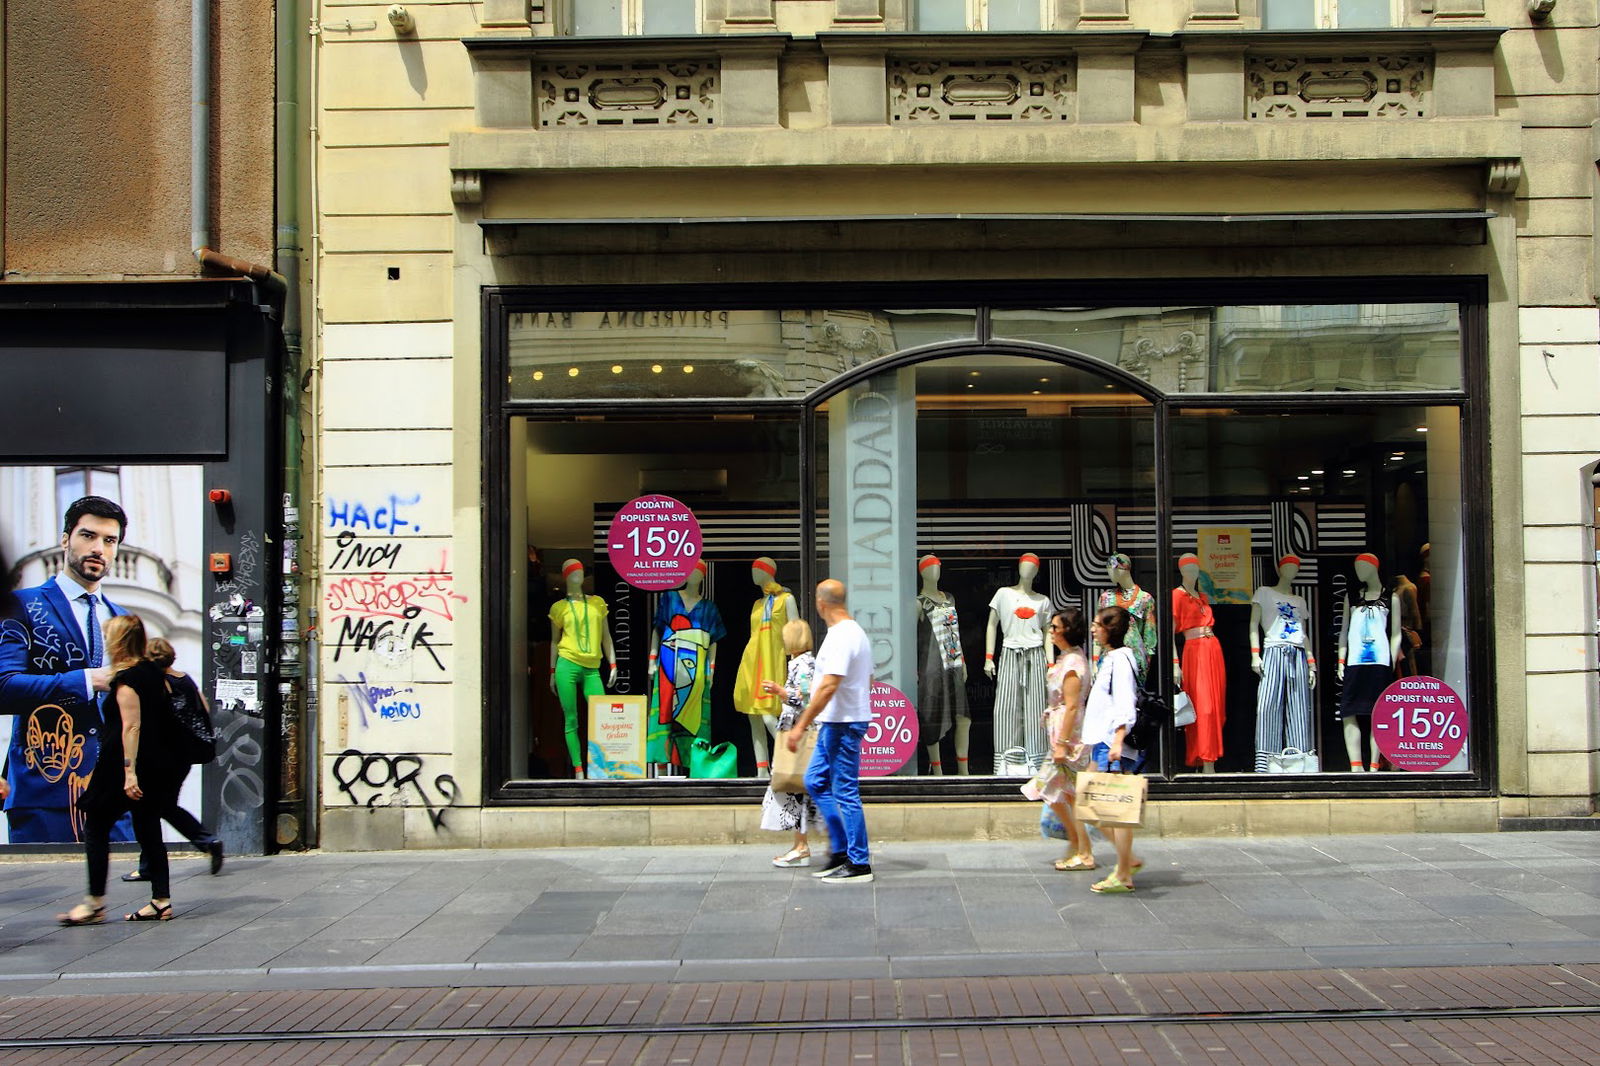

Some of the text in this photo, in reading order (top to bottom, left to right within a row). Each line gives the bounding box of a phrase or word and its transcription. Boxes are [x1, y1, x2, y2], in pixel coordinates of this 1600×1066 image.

[853, 391, 893, 592] HADDAD
[635, 501, 674, 509] DODATNI
[620, 513, 689, 522] POPUST NA SVE
[612, 526, 696, 557] -15%
[633, 560, 679, 569] ALL ITEMS
[1400, 681, 1440, 690] DODATNI
[869, 687, 891, 695] ATNI
[1385, 694, 1421, 703] POPUST
[1422, 695, 1436, 703] NA
[888, 699, 906, 708] SVE
[1376, 707, 1461, 739] -15%
[864, 713, 912, 743] 5%
[869, 746, 896, 755] ITEMS
[1398, 742, 1444, 750] ALL ITEMS
